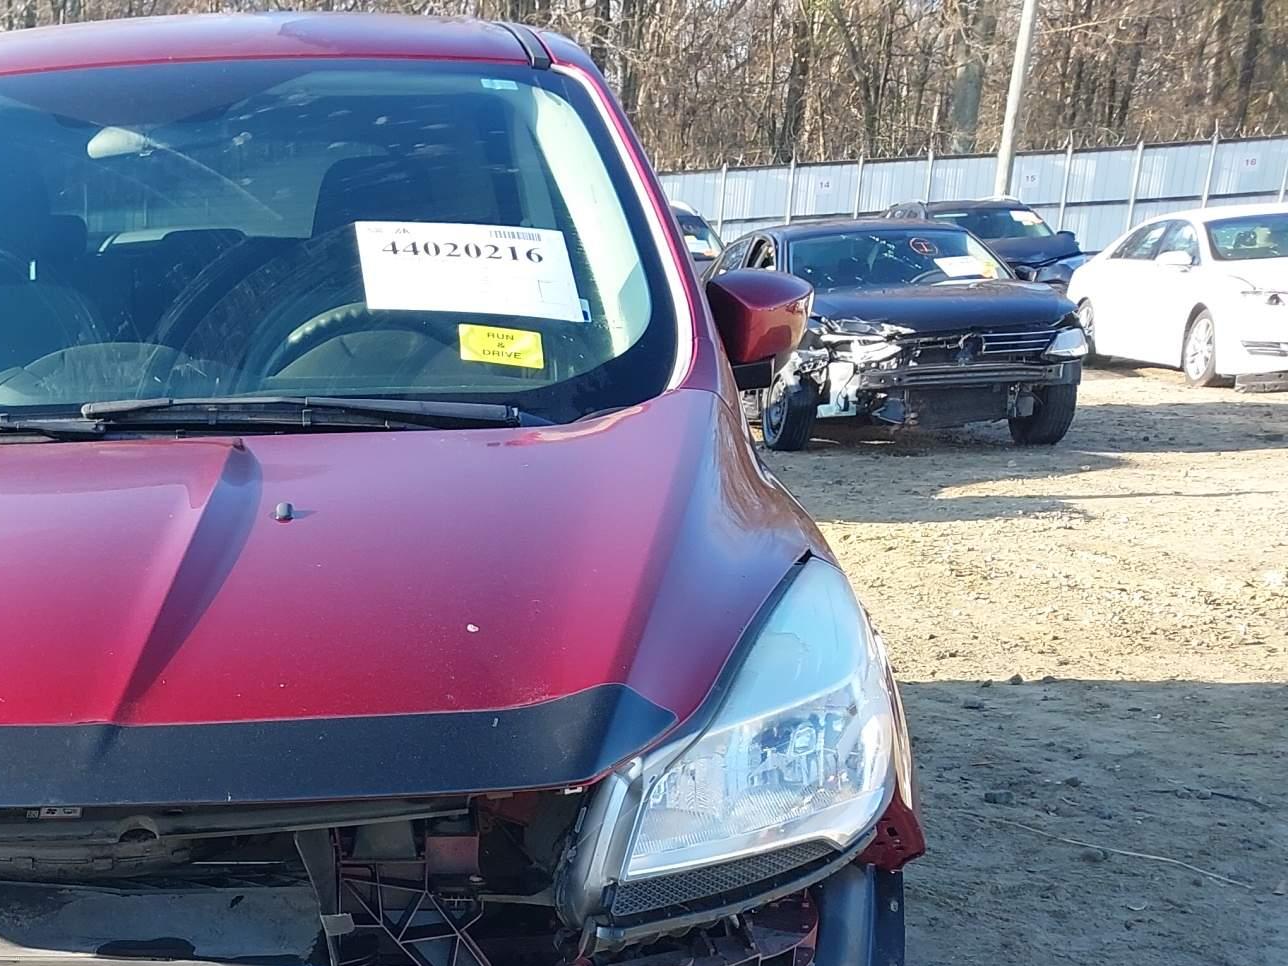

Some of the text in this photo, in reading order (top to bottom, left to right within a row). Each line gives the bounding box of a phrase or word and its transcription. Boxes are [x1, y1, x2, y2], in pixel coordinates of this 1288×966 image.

[382, 240, 543, 264] 44020216
[487, 332, 514, 341] RUN
[482, 349, 522, 359] DRIVE
